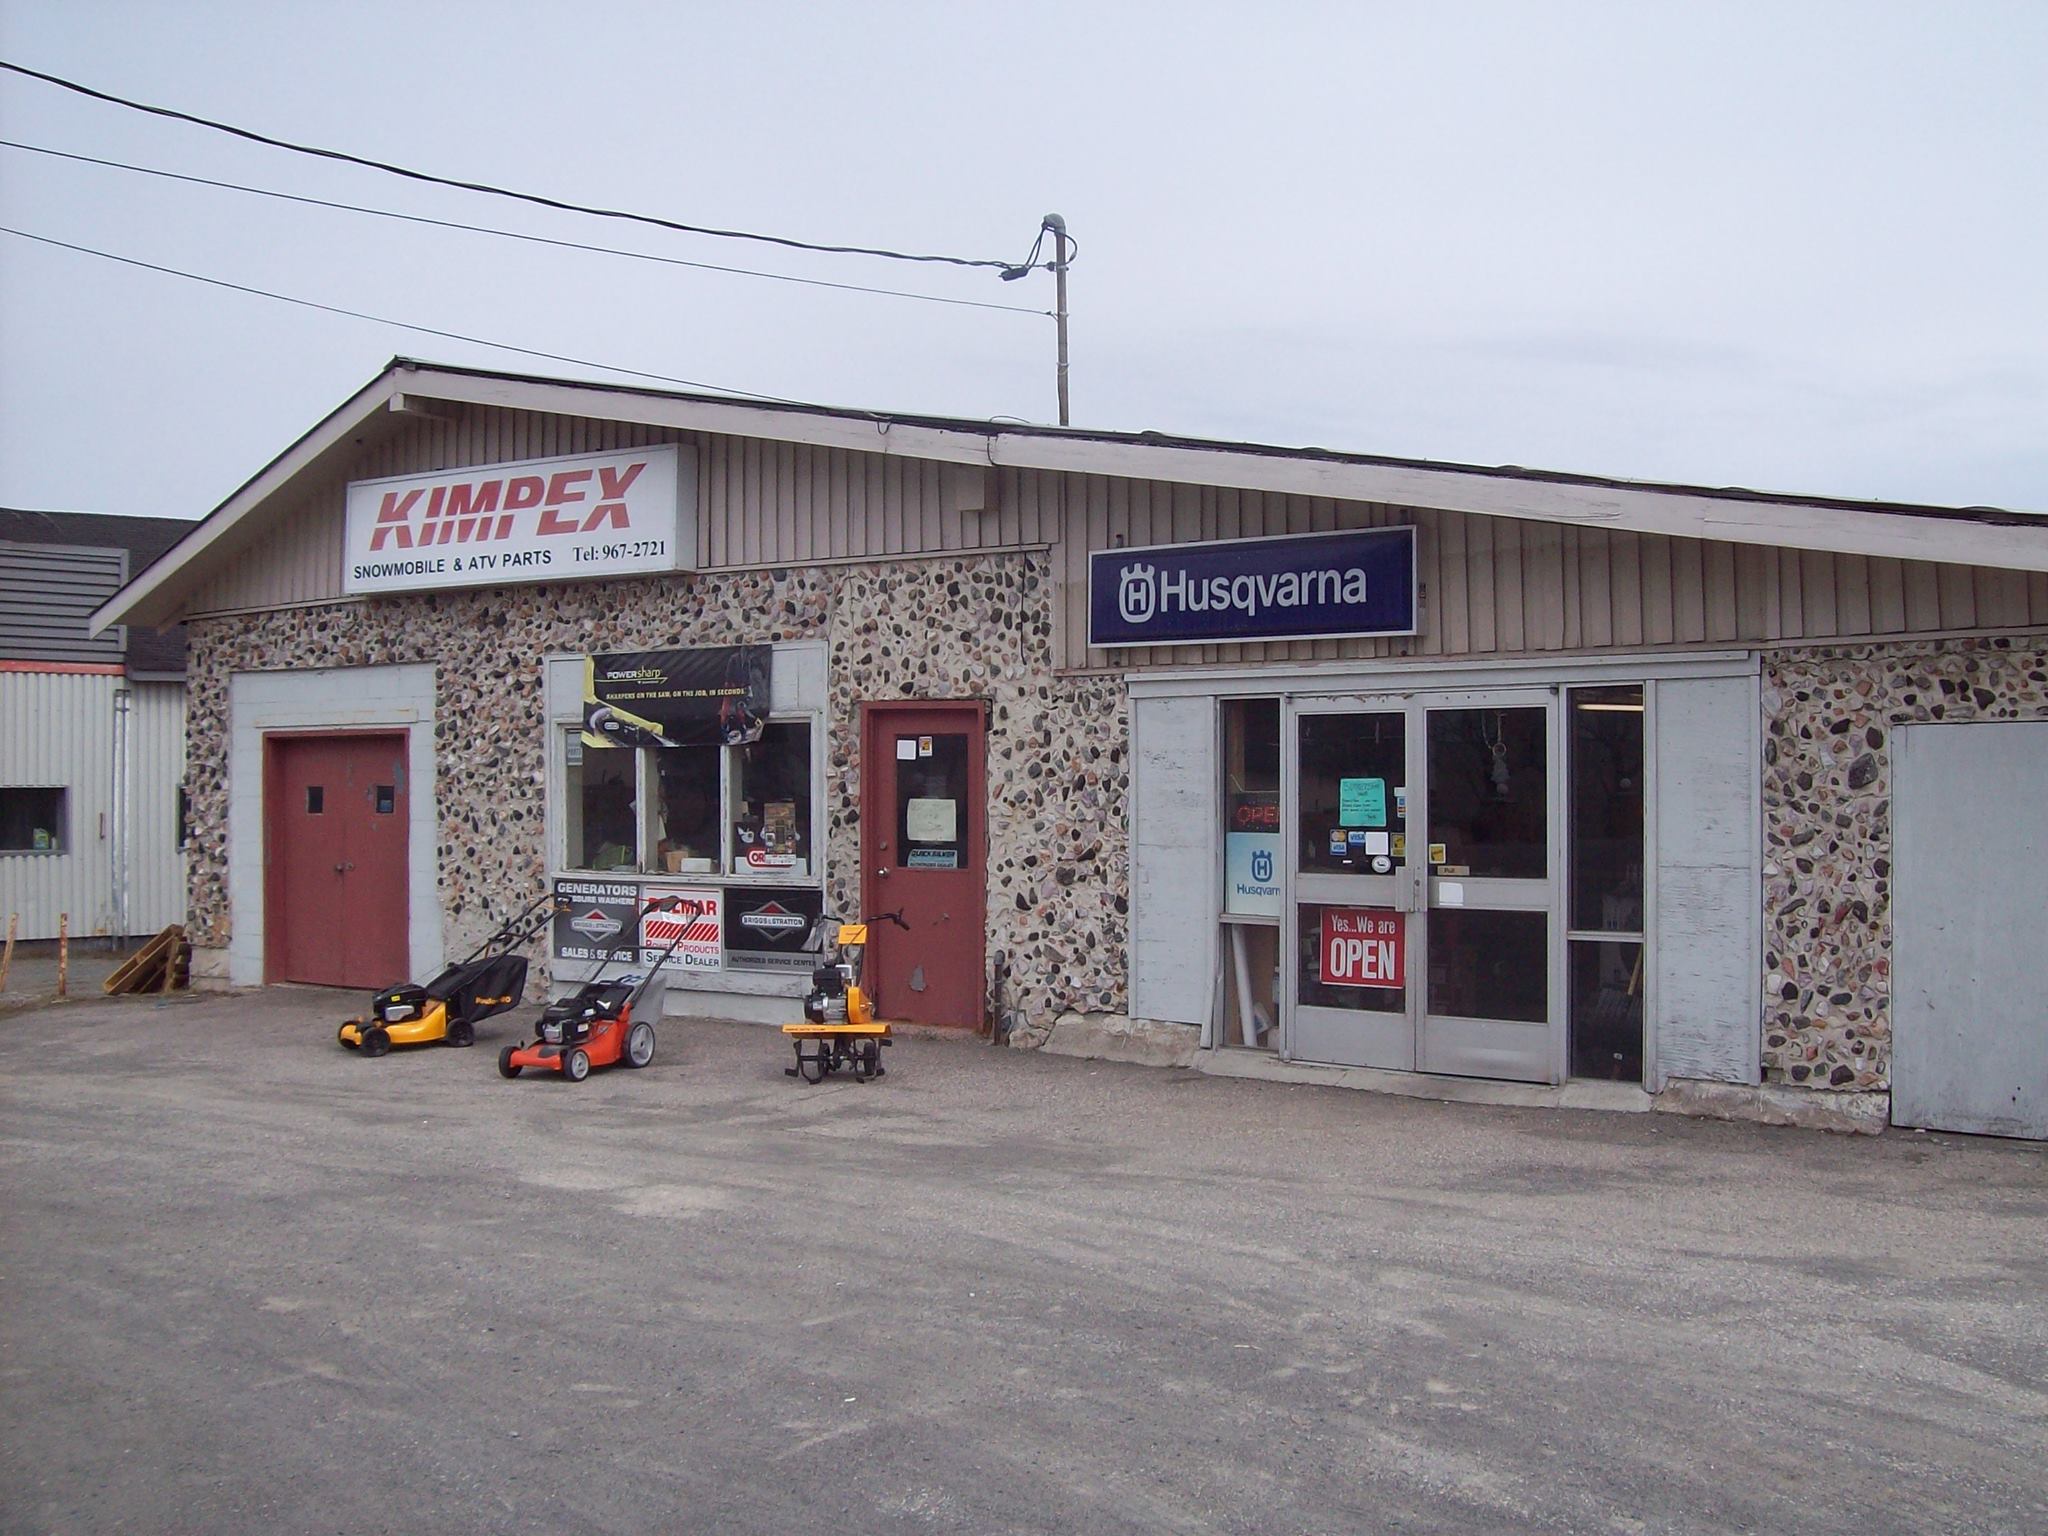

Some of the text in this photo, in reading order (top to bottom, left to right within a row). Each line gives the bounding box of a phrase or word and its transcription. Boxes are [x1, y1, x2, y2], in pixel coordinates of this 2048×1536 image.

[369, 462, 648, 552] KIMPEX
[573, 540, 665, 562] Tel: 967-2721
[354, 550, 552, 579] SNOWMOBILE & ATV PARTS
[1160, 567, 1367, 616] Husqvarna
[646, 691, 657, 699] THE
[557, 882, 637, 897] GENERATORS
[1378, 920, 1396, 934] are
[561, 947, 588, 958] SALES
[596, 950, 633, 961] SEVICE
[677, 941, 719, 954] PRODUCTS
[685, 953, 719, 967] DEALER
[1330, 937, 1396, 980] OPEN
